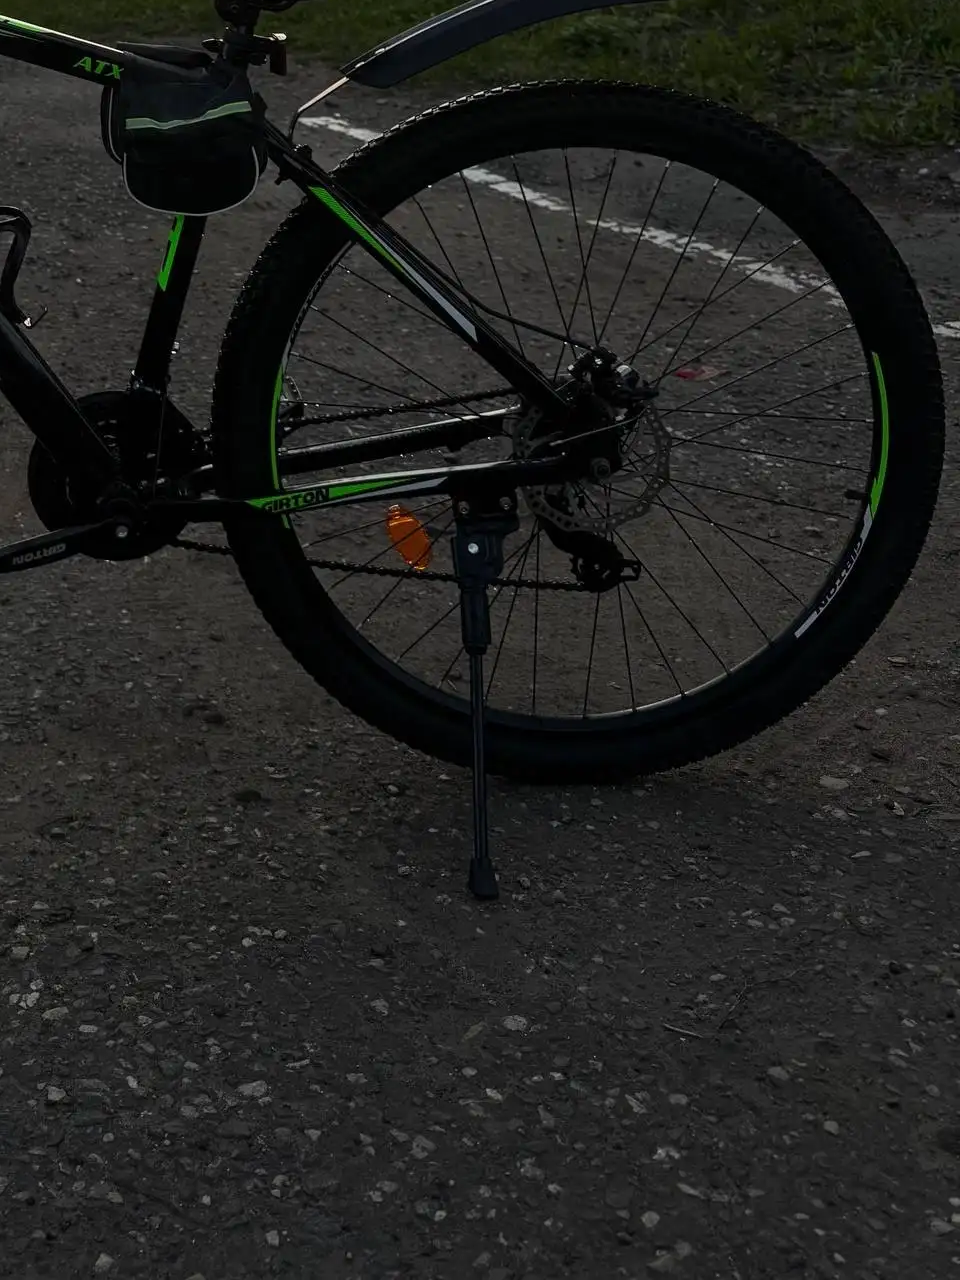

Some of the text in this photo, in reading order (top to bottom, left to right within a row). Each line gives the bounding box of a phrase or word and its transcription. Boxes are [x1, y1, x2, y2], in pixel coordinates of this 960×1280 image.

[73, 56, 124, 80] ATX
[264, 486, 329, 514] GIRTON
[12, 543, 67, 565] GIRTON
